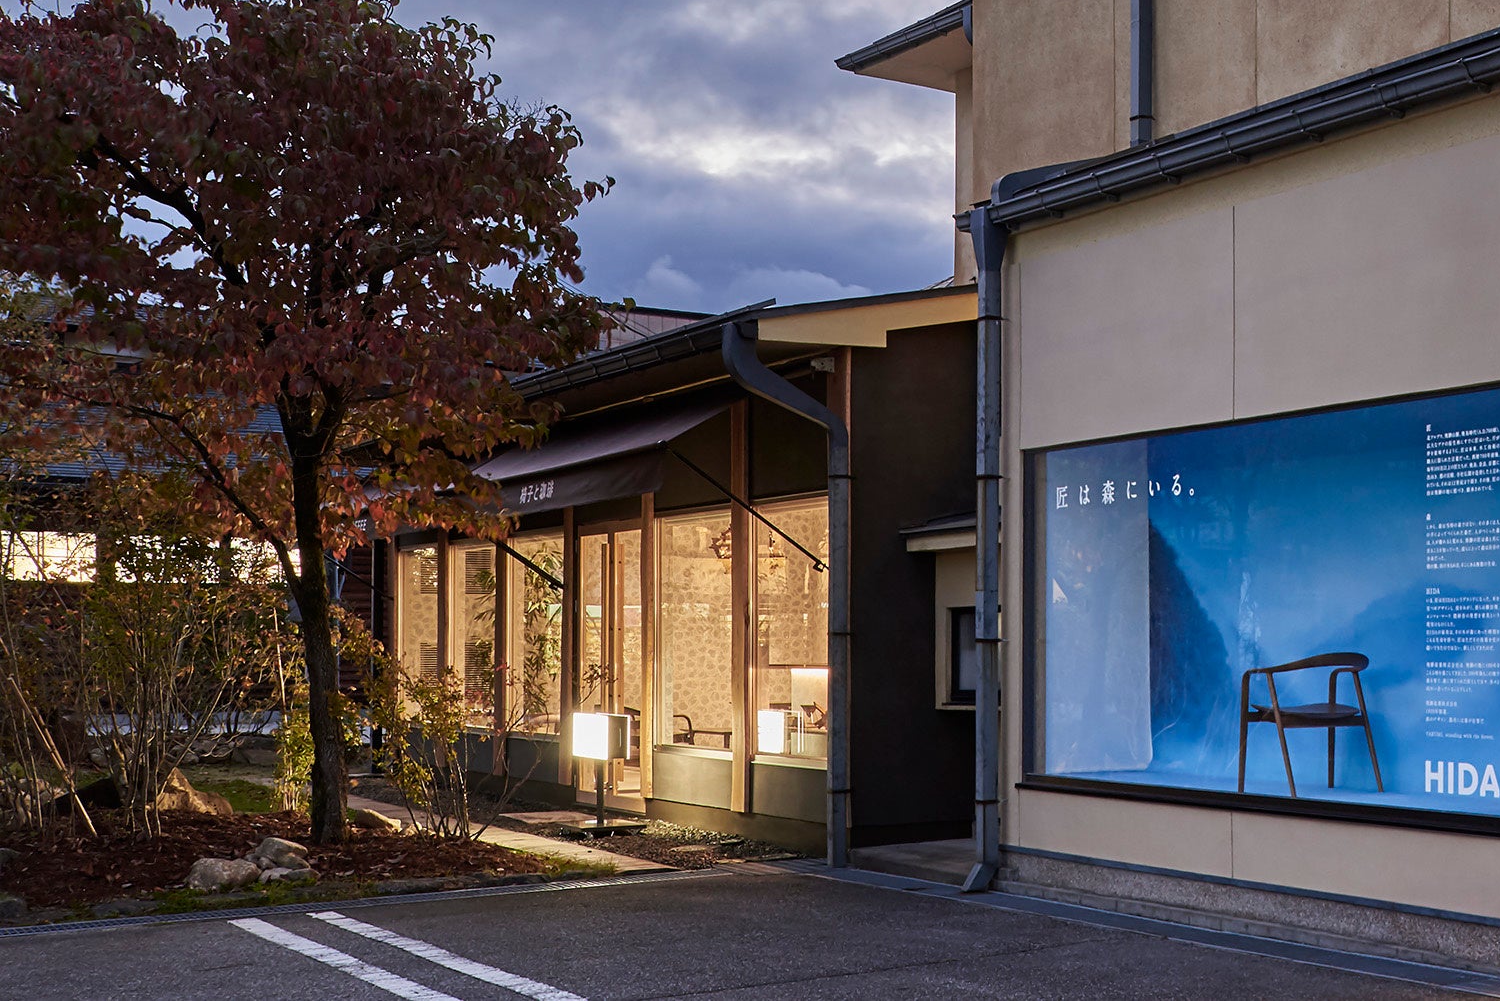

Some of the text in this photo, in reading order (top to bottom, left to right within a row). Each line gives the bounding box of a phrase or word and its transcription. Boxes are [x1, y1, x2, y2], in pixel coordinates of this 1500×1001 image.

[1056, 474, 1195, 509] 匠は森にいる。
[1425, 760, 1500, 798] HIDA
